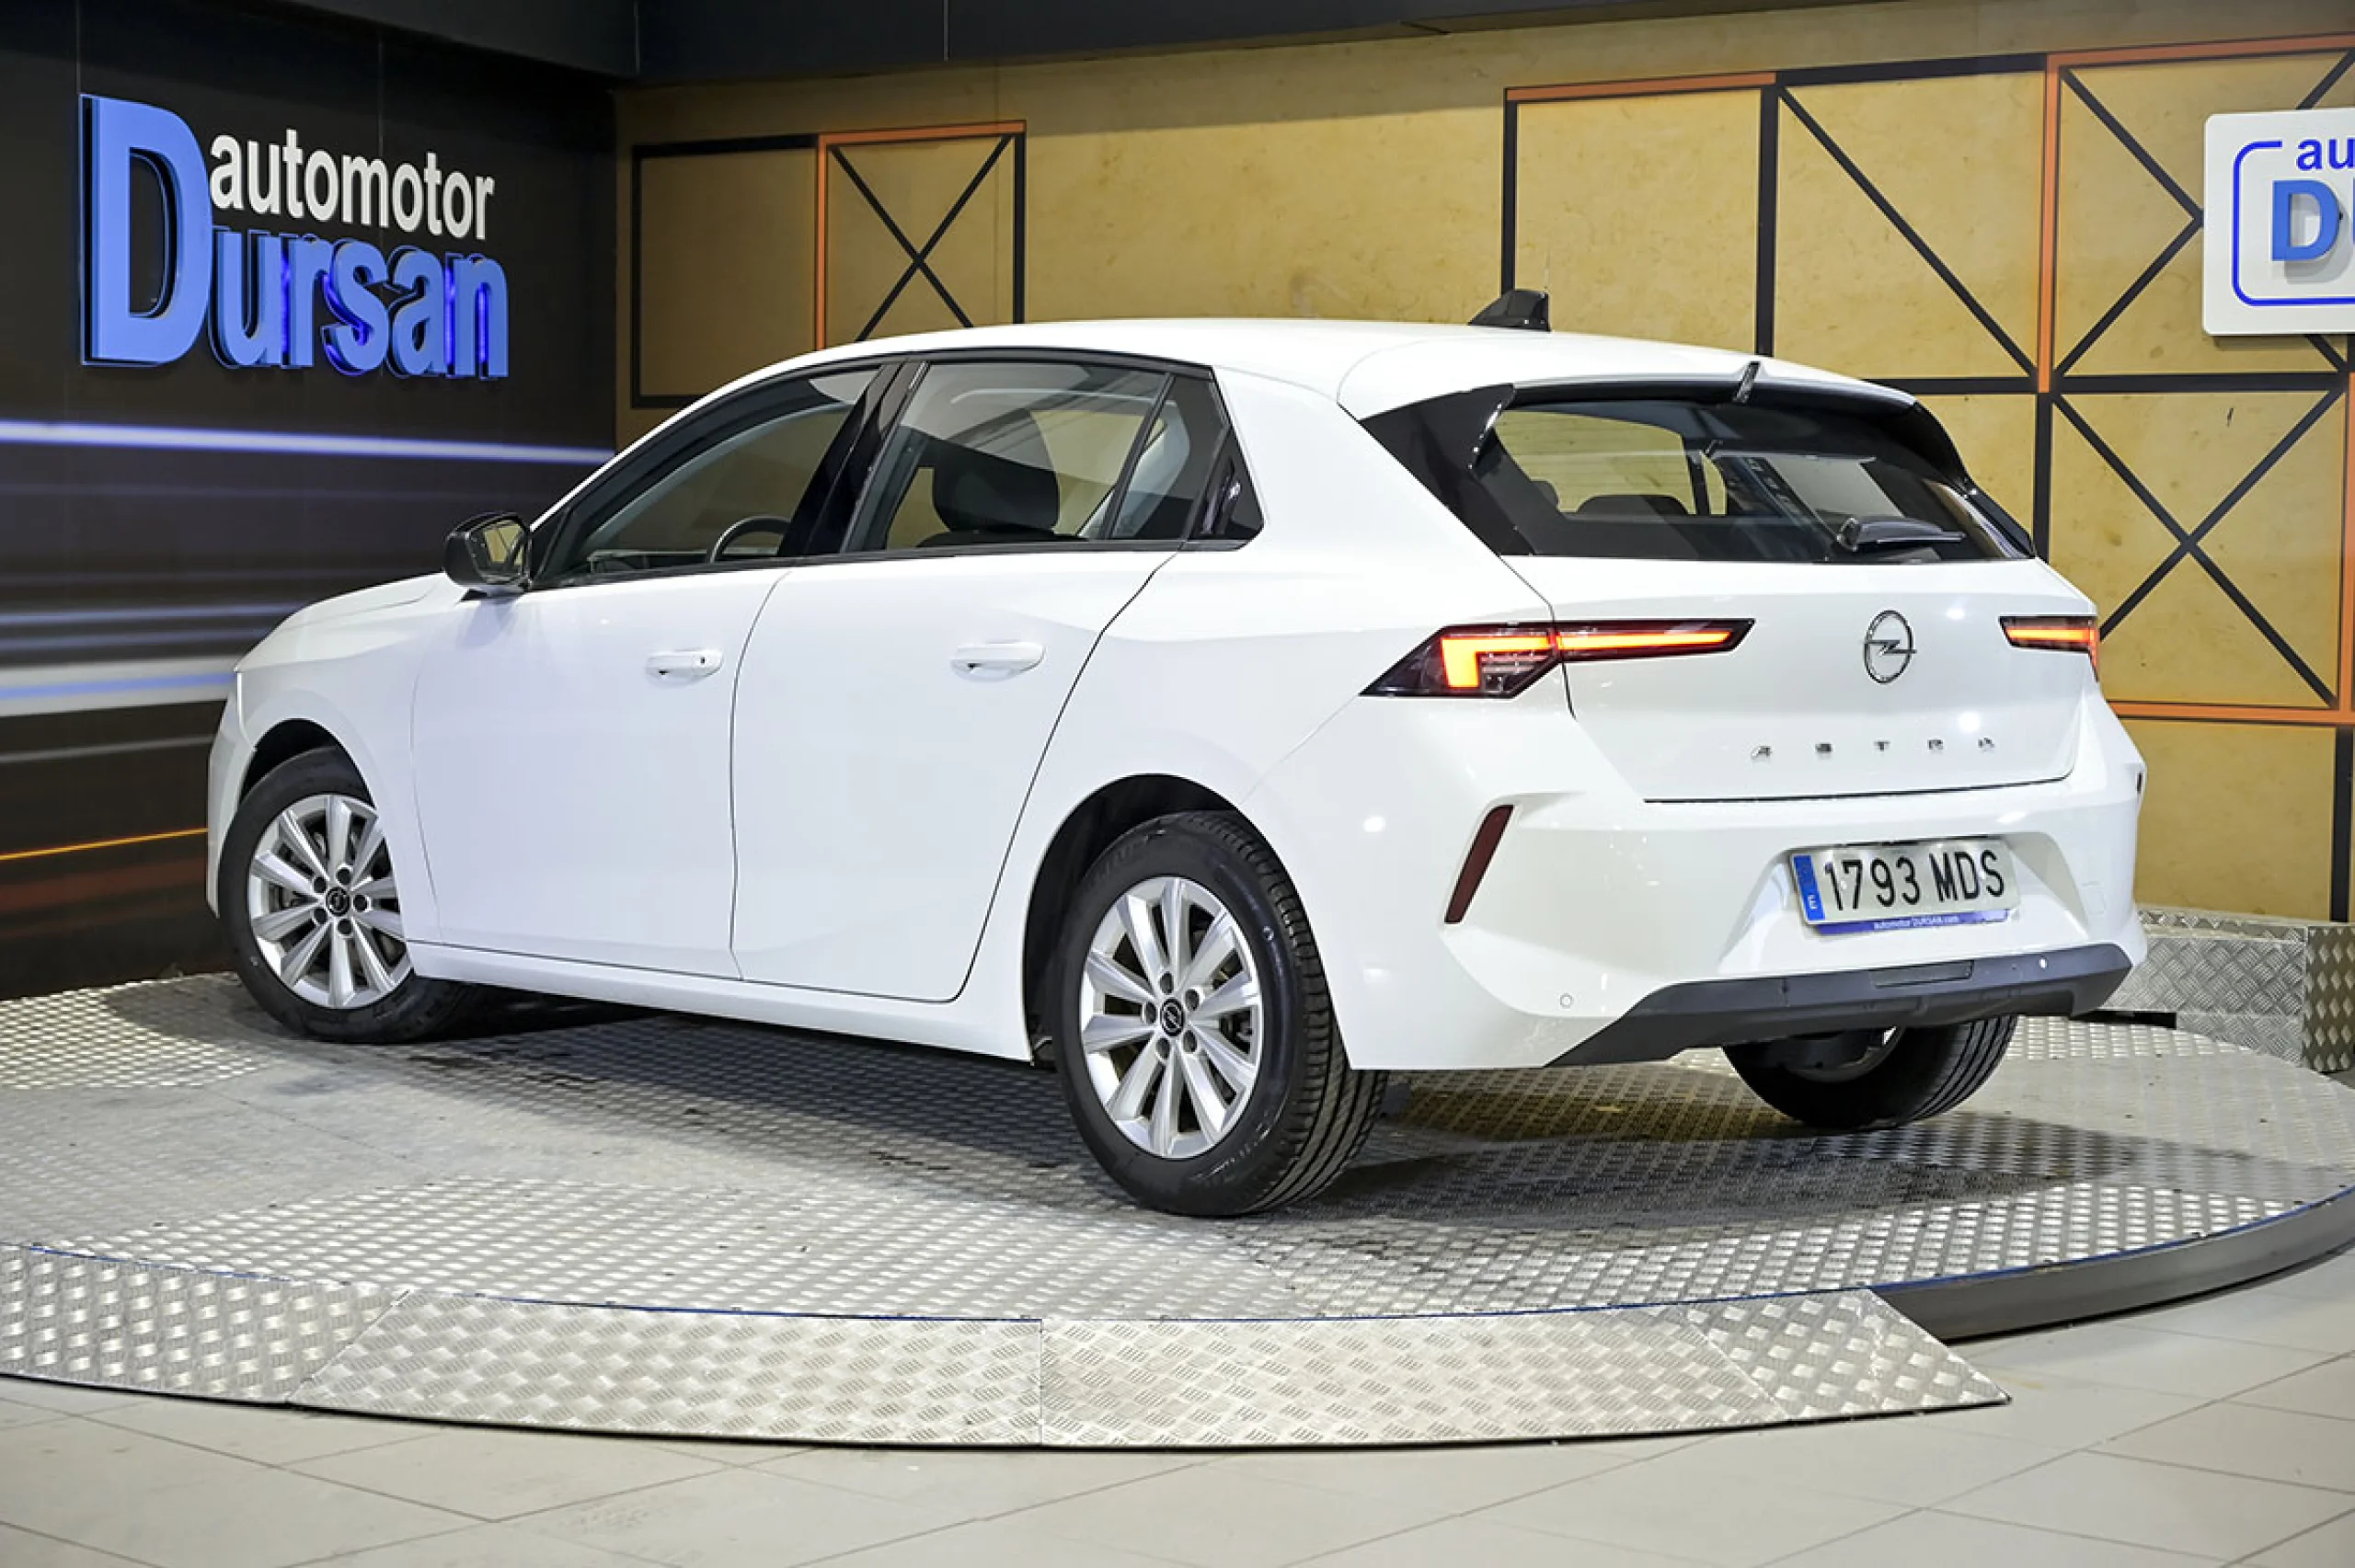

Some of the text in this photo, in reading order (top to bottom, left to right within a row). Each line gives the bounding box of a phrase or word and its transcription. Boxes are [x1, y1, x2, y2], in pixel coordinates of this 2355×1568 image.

[209, 129, 495, 240] automotor
[2271, 180, 2355, 261] D
[79, 93, 509, 379] Dursan
[1807, 894, 1818, 910] E
[1824, 849, 2005, 911] 1793 MDS
